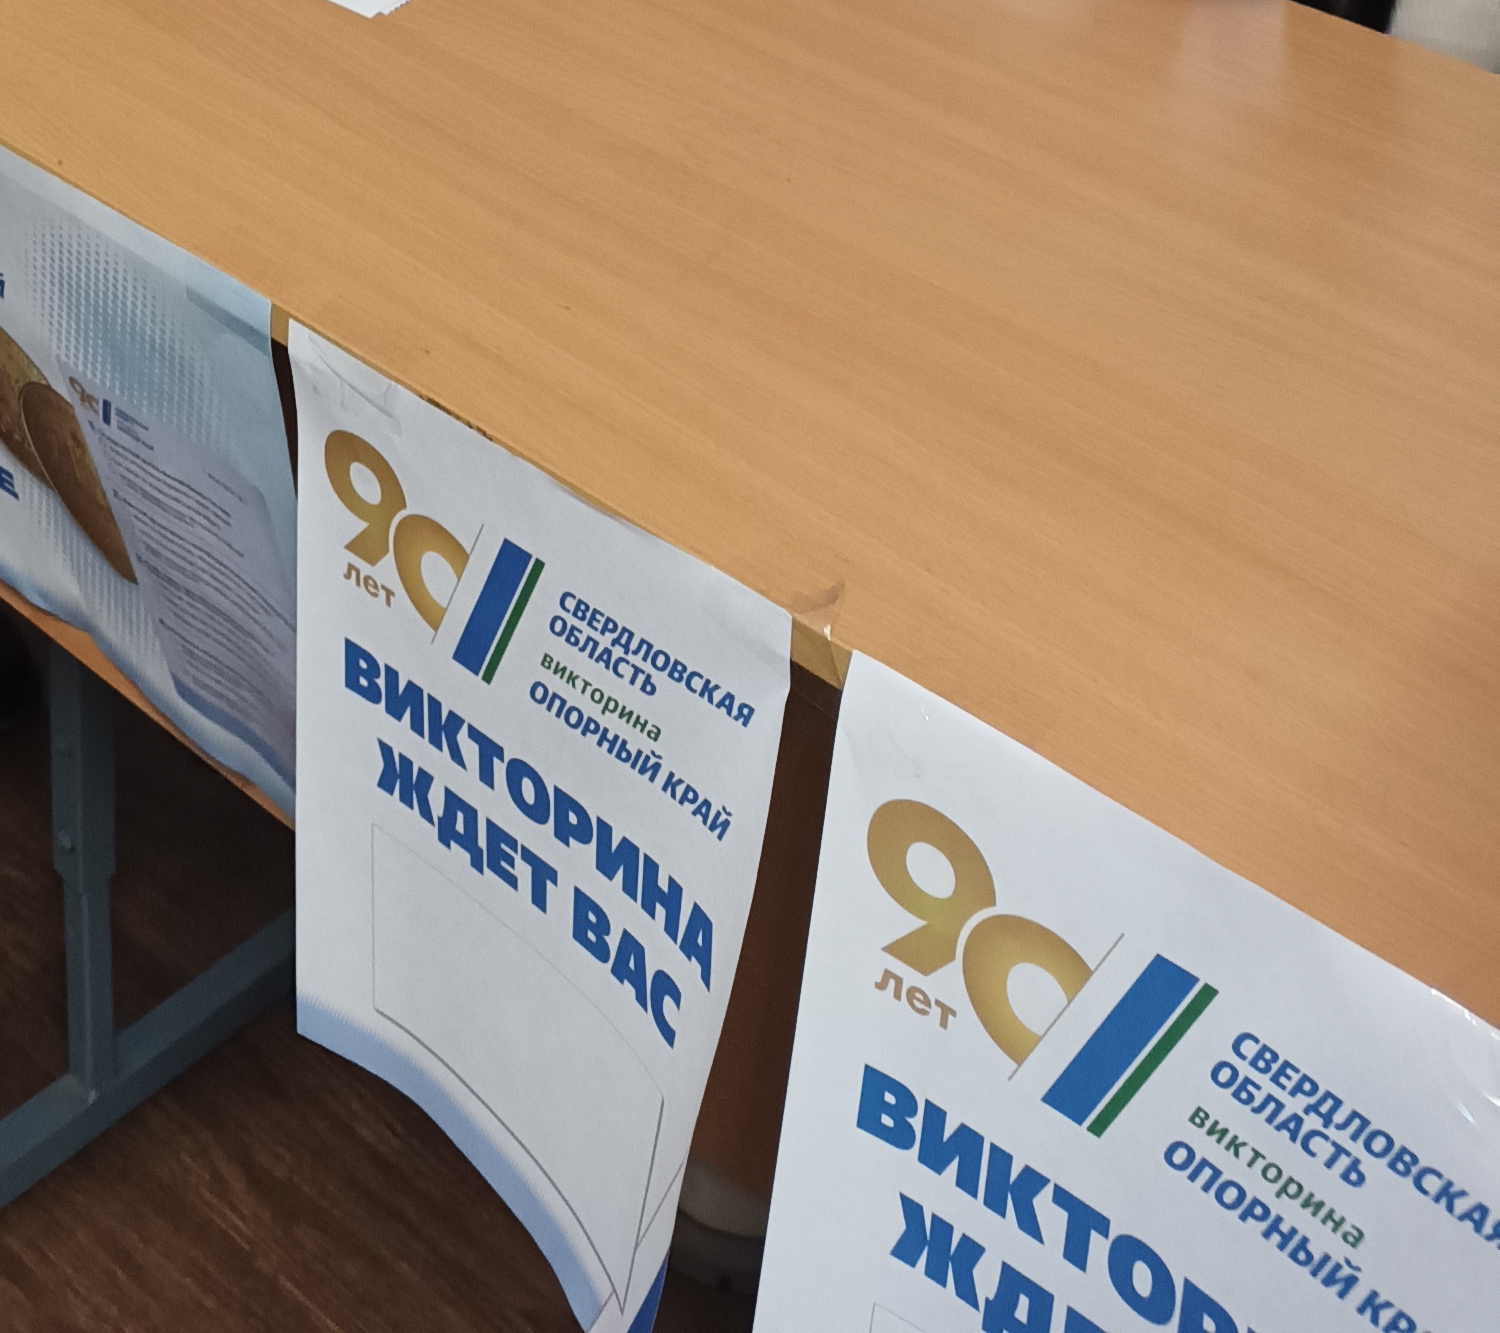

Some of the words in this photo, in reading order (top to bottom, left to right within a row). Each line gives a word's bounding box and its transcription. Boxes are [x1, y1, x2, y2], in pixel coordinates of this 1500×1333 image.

[343, 561, 396, 608] лет
[549, 614, 658, 697] ОБЛАСТЬ
[540, 652, 662, 743] викторина
[559, 591, 756, 728] СВЕРДЛОВСКАЯ
[344, 637, 714, 993] ВИКТОРИНА
[529, 680, 663, 784] ОПОРНЫЙ
[661, 770, 733, 842] КРАЙ
[377, 737, 559, 915] ЖДЕТ
[572, 885, 683, 1050] ВАС
[875, 968, 958, 1030] лет
[1188, 1105, 1366, 1250] викторина
[1210, 1040, 1367, 1188] ОБЛАСТЬ
[856, 1063, 1260, 1333] ВИКТОР
[1163, 1140, 1362, 1300] ОПОРНЫЙ
[1356, 1289, 1433, 1333] КР
